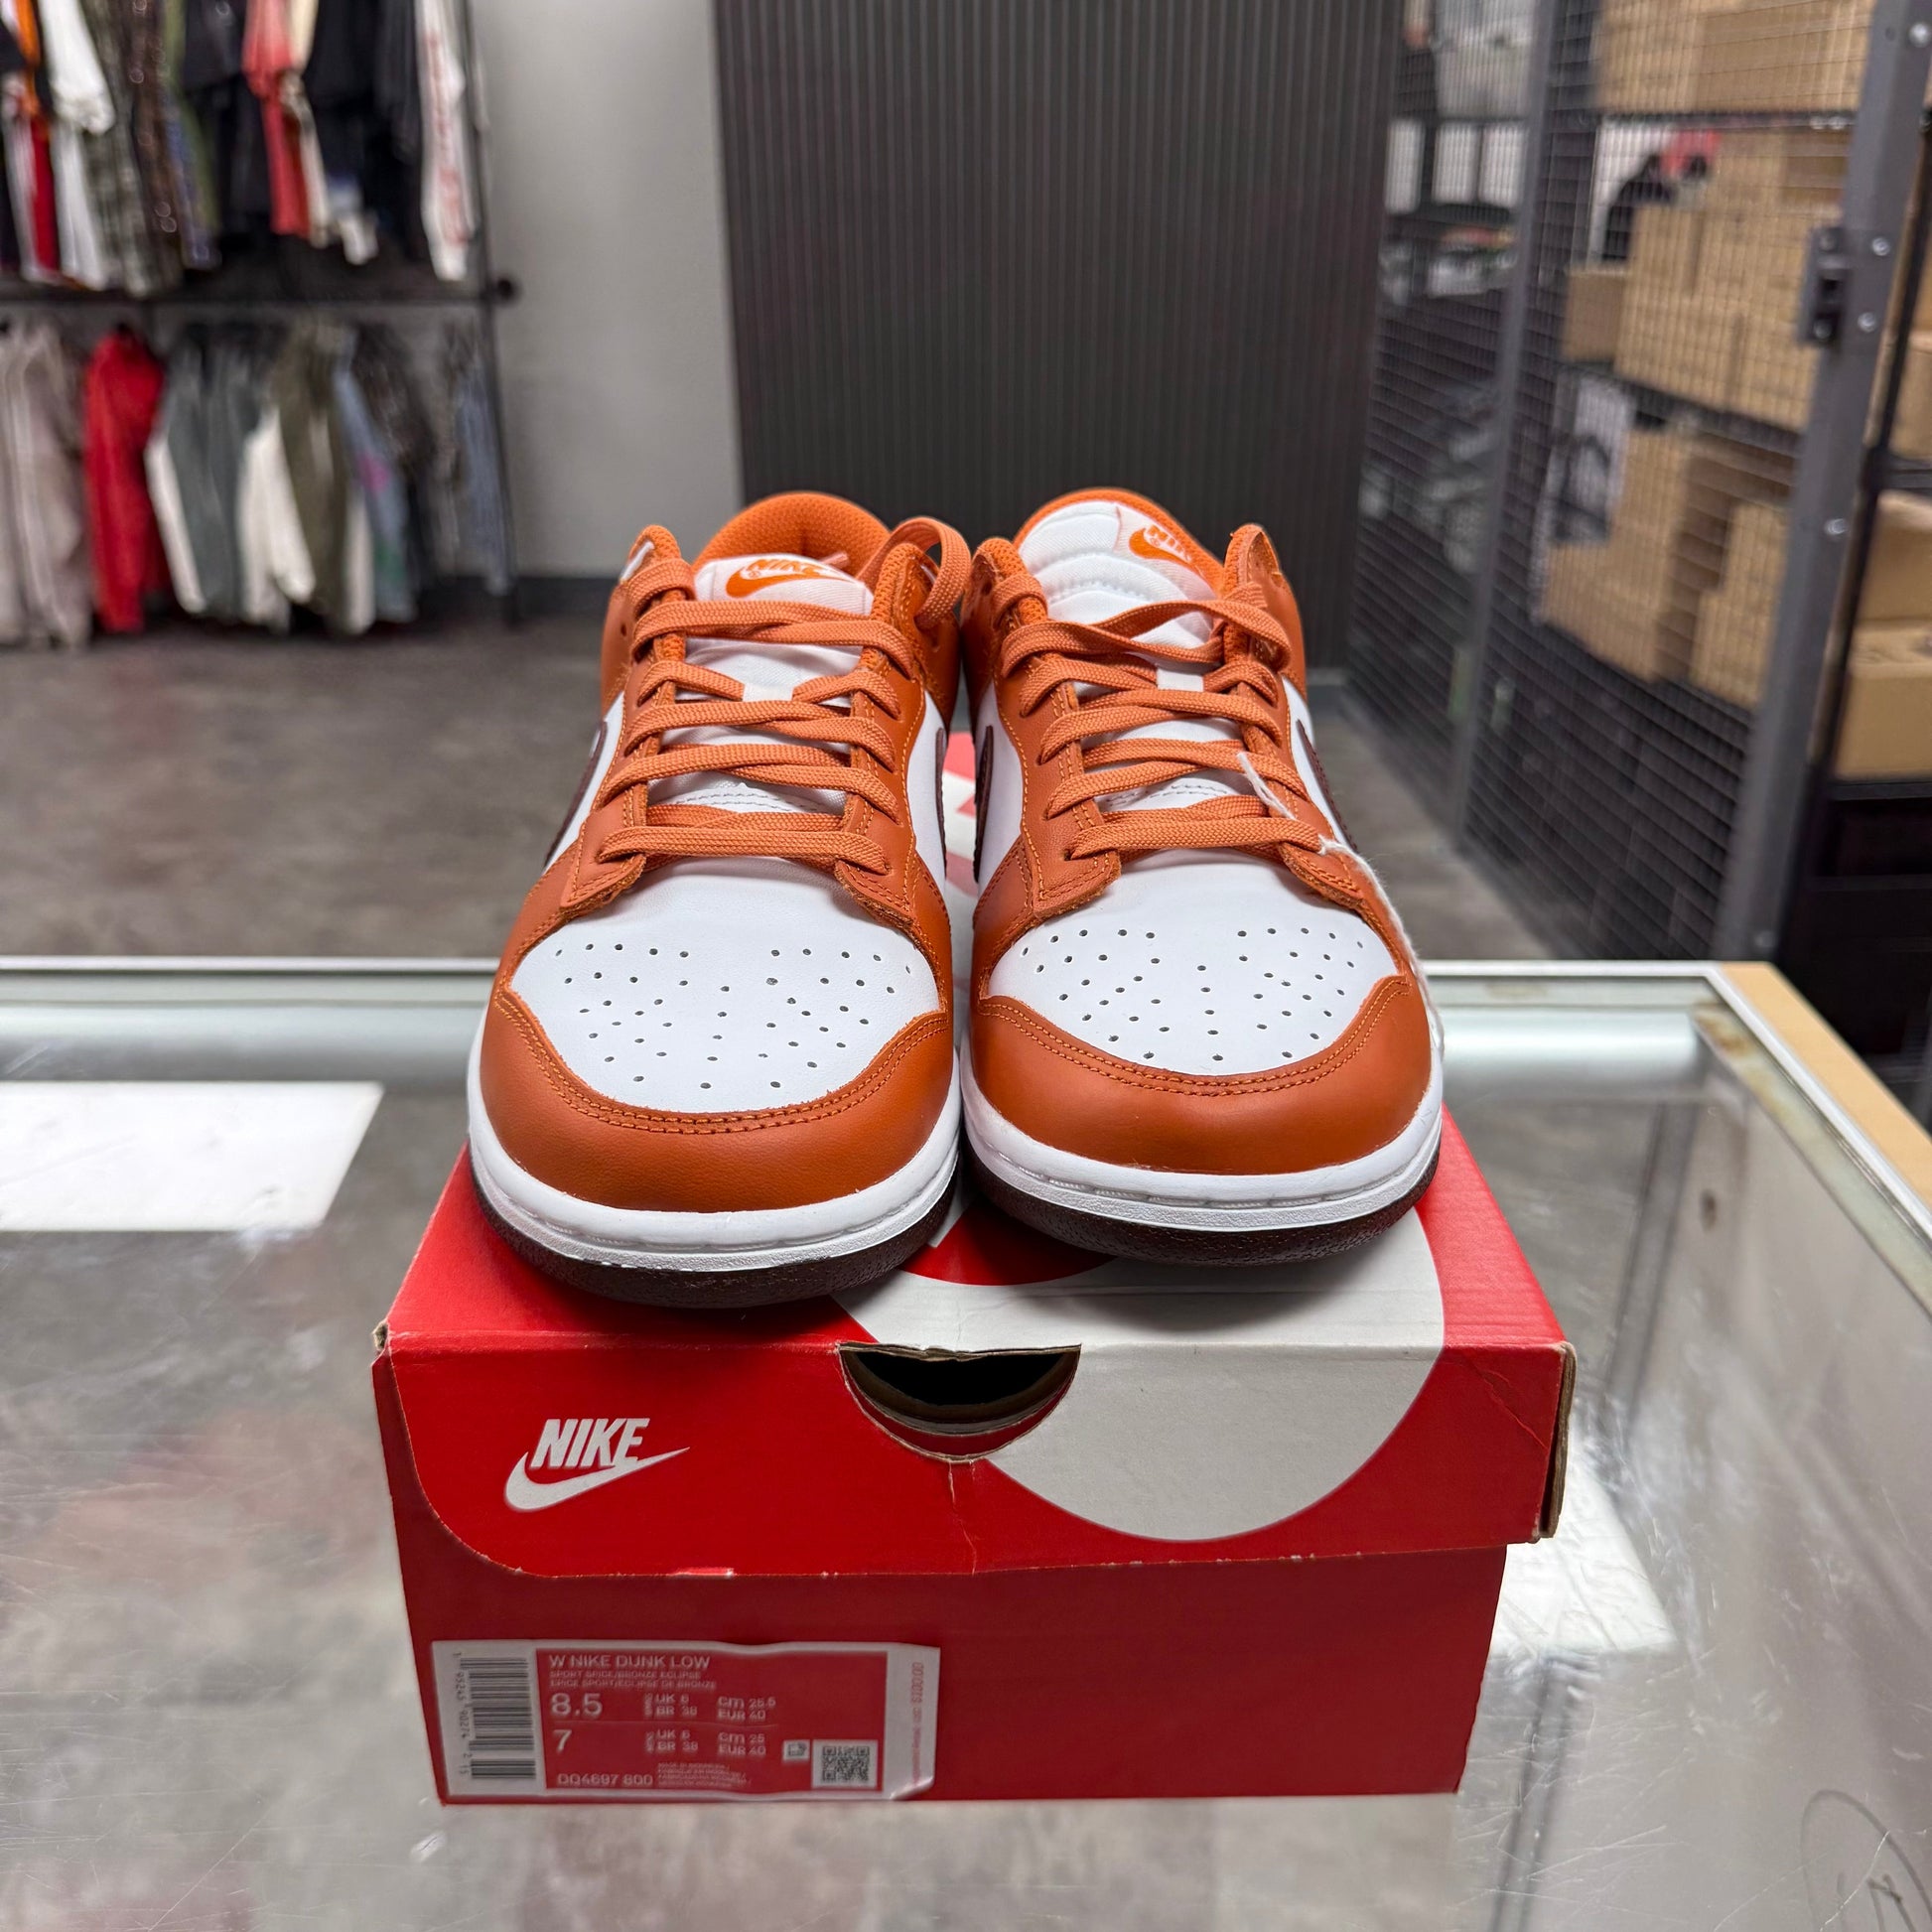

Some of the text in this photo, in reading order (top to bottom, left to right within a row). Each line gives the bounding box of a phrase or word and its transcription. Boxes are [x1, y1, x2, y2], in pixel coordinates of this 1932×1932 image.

[529, 1418, 650, 1468] NIKE
[549, 1655, 711, 1670] W NIKE DUNK LOW
[551, 1692, 602, 1717] 8.5
[656, 1694, 676, 1704] UK
[717, 1696, 745, 1709] cm
[656, 1706, 698, 1717] BR 38
[717, 1709, 766, 1722] EUR 40
[553, 1728, 573, 1753] 7
[657, 1729, 676, 1739] UK
[718, 1731, 764, 1744] cm 25
[657, 1740, 676, 1751] BR
[682, 1740, 699, 1751] 38
[718, 1743, 766, 1756] EUR 40
[622, 1773, 653, 1786] 800
